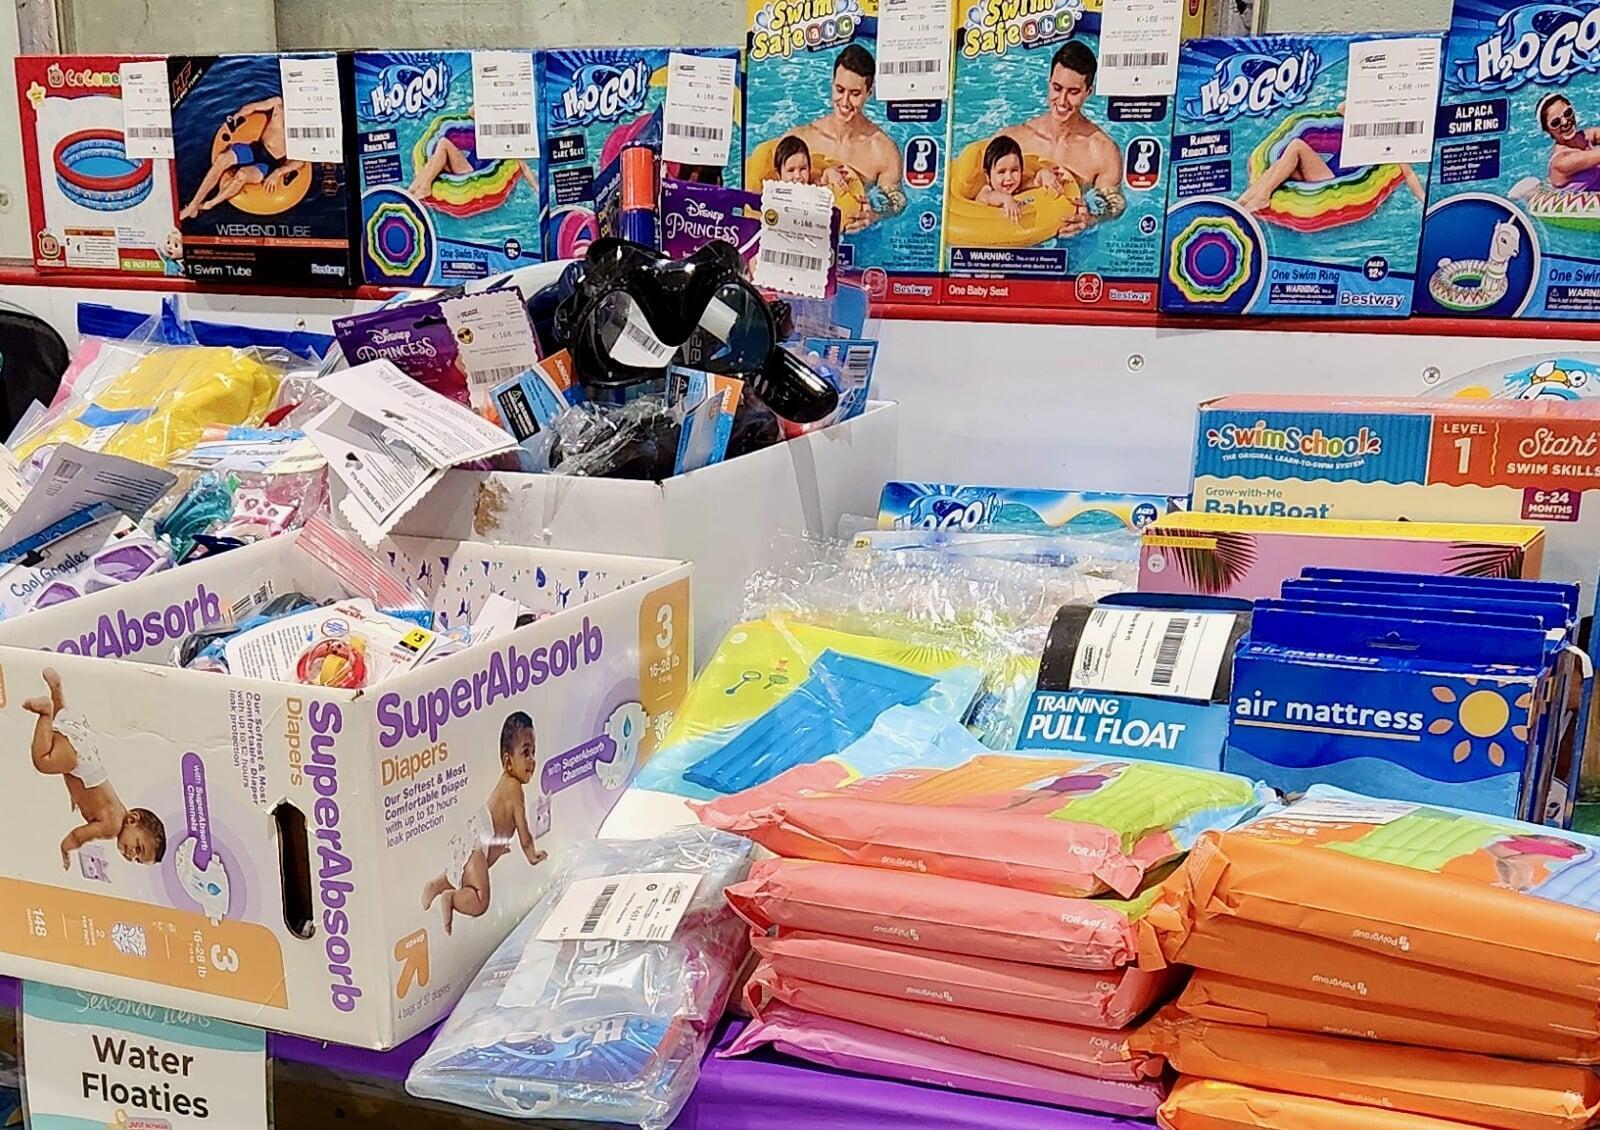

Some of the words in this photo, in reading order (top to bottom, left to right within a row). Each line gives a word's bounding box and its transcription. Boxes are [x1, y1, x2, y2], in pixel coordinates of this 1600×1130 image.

[770, 0, 835, 31] Swim
[984, 0, 1053, 27] Swim
[752, 27, 806, 60] Safe
[964, 23, 1022, 56] Safe
[1477, 7, 1600, 83] H2OGO
[65, 67, 119, 87] CoCome
[1201, 49, 1311, 114] H2OGO!
[1449, 120, 1472, 134] SWIM
[1474, 117, 1499, 131] RING
[1455, 105, 1493, 119] ALPACA
[552, 149, 569, 160] CARE
[684, 198, 726, 226] Disney
[216, 224, 277, 236] WEEKEND
[279, 225, 312, 237] TUBE
[665, 212, 740, 248] PRINCESS
[969, 251, 1015, 261] WARNING:
[188, 266, 193, 275] 1
[194, 265, 223, 276] Swim
[225, 265, 252, 277] Tube
[1271, 268, 1290, 280] One
[1291, 268, 1317, 281] Swim
[1318, 269, 1341, 282] Ring
[1549, 269, 1572, 281] One
[949, 285, 966, 295] One
[967, 286, 989, 298] Baby
[989, 286, 1009, 296] Seat
[1109, 289, 1152, 302] Bestway
[1340, 291, 1405, 309] Bestway
[356, 337, 437, 360] PRINCESS
[366, 328, 411, 345] Disney
[1219, 420, 1369, 457] SwimSchool
[1443, 423, 1487, 434] LEVEL
[1454, 437, 1472, 474] 1
[1518, 427, 1598, 458] Start
[1238, 453, 1273, 461] ORIGINAL
[1335, 459, 1365, 470] SYSTEM
[1506, 463, 1548, 474] SWIM
[1552, 464, 1600, 477] SKILLS
[1205, 487, 1283, 498] Grow-with-Me
[1534, 491, 1570, 503] 6-24
[1205, 499, 1330, 518] BabyBoat
[1528, 504, 1573, 514] MONTHS
[10, 567, 44, 598] Cool
[40, 549, 90, 586] Goggles
[40, 583, 221, 658] erAbsorb
[656, 603, 673, 649] 3
[649, 655, 672, 679] 16-28
[1250, 646, 1282, 655] air
[1284, 649, 1380, 664] mattress
[376, 616, 603, 749] SuperAbsorb
[237, 690, 245, 712] with
[253, 693, 261, 712] Our
[1036, 695, 1120, 714] TRAINING
[1235, 690, 1277, 717] air
[1285, 699, 1425, 731] mattress
[238, 715, 245, 731] up
[246, 691, 256, 764] Comfortable
[1027, 714, 1087, 742] PULL
[1094, 718, 1187, 750] FLOAT
[229, 714, 240, 767] protection
[240, 733, 246, 743] to
[255, 717, 264, 763] Softest
[284, 697, 303, 786] Diapers
[382, 741, 449, 787] Diapers
[250, 767, 259, 805] Diaper
[259, 775, 267, 804] Most
[384, 792, 400, 808] Our
[403, 778, 435, 800] Softest
[437, 773, 444, 784] &
[445, 763, 467, 780] Most
[385, 792, 440, 821] Comfortable
[441, 775, 469, 798] Diaper
[187, 784, 197, 832] Channels
[195, 787, 209, 852] SuperAbsorb
[385, 819, 403, 836] with
[404, 814, 415, 827] up
[416, 809, 425, 821] to
[426, 806, 435, 817] 12
[436, 795, 458, 812] hours
[386, 832, 404, 849] leak
[405, 813, 445, 843] protection
[303, 700, 363, 1014] SuperAbsorb
[1068, 845, 1088, 856] FOR
[31, 907, 48, 938] 148
[1061, 913, 1081, 925] FOR
[96, 930, 105, 938] 2
[192, 929, 205, 964] 16-28
[1351, 928, 1398, 947] Polygroup
[198, 965, 208, 978] lb
[209, 943, 239, 973] 3
[1095, 980, 1116, 992] FOR
[1312, 974, 1356, 992] Polygroup
[75, 990, 155, 1020] Seasonal
[162, 1009, 211, 1026] Items
[92, 1033, 194, 1077] Water
[1089, 1036, 1109, 1049] FOR
[81, 1071, 209, 1119] Floaties
